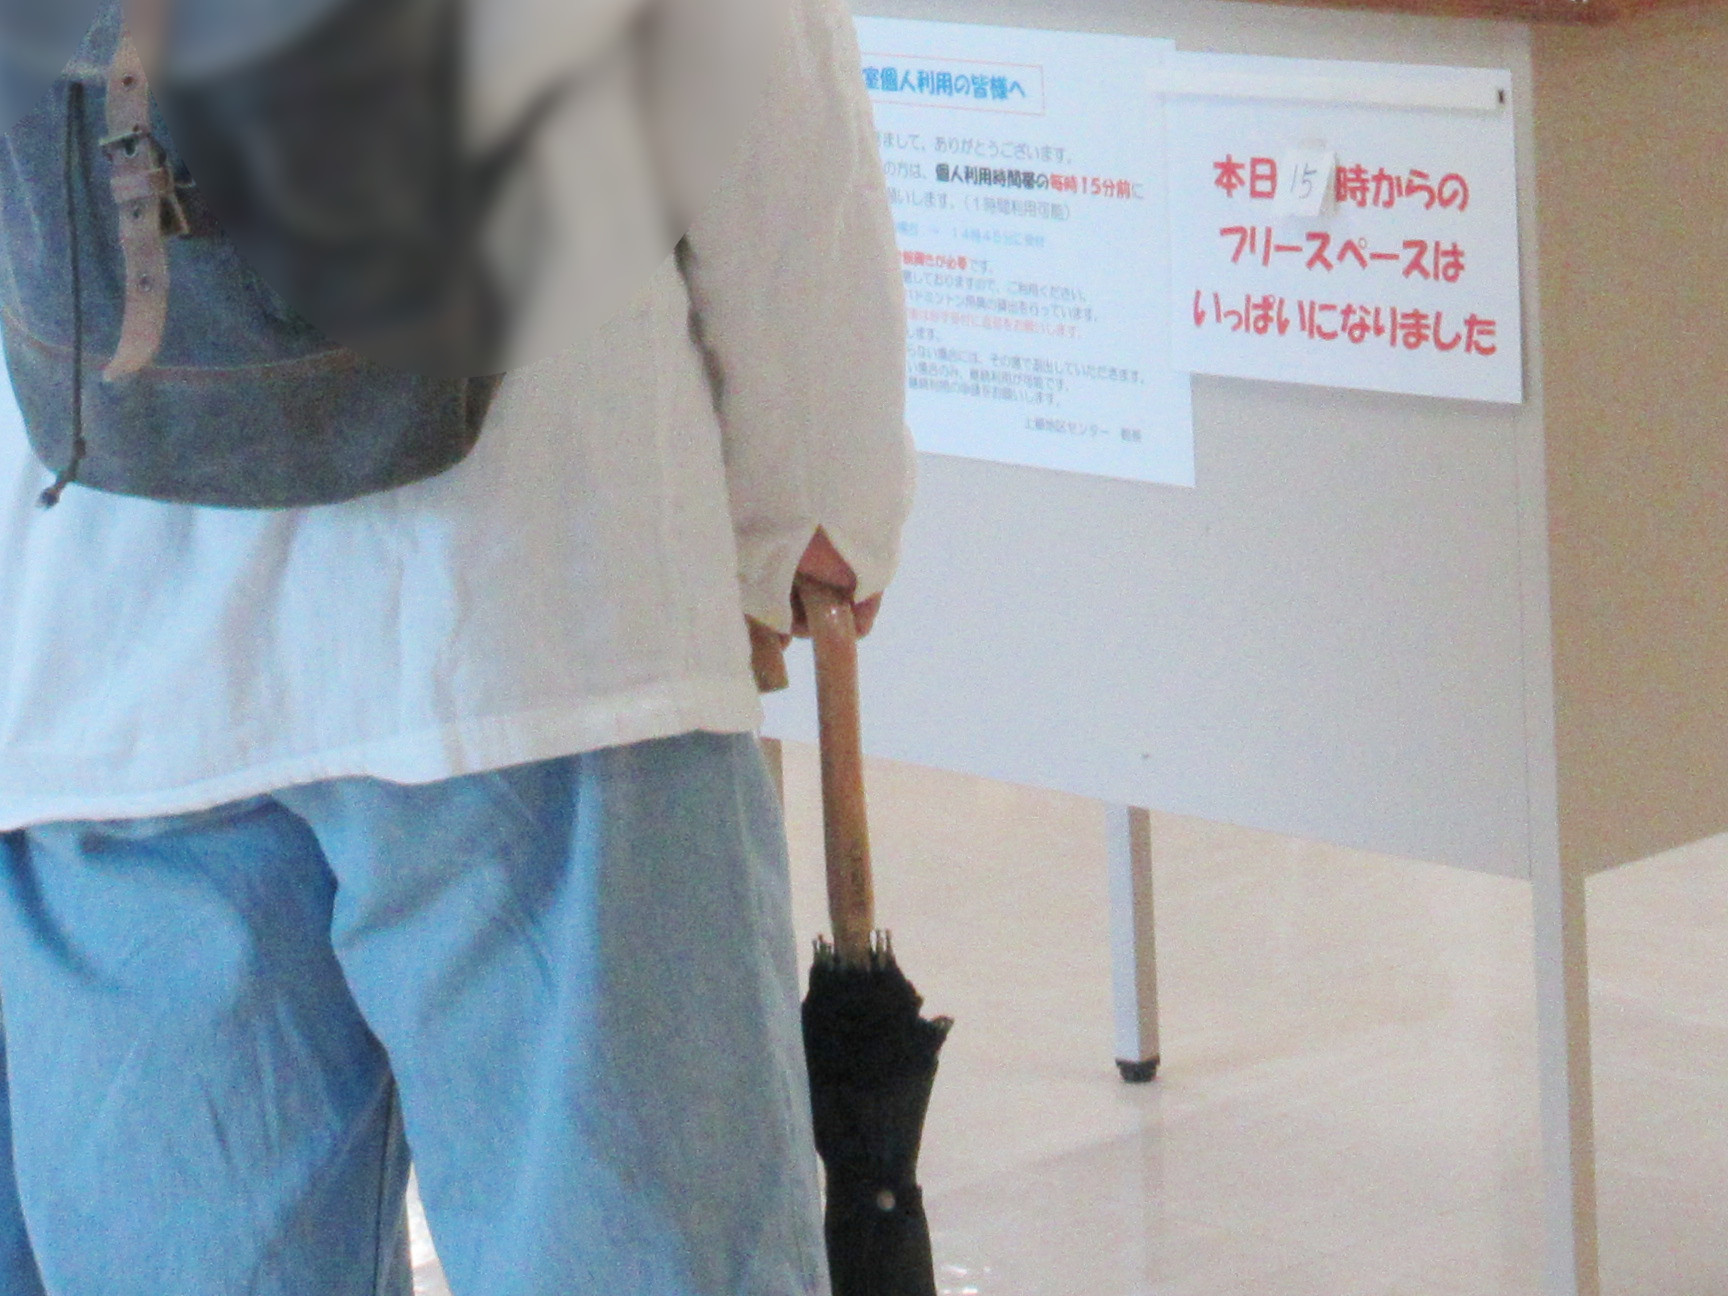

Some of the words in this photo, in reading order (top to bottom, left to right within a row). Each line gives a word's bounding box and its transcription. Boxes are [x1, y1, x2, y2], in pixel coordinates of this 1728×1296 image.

[1220, 226, 1466, 283] フリースペースは
[1193, 289, 1497, 356] いっぱいになりました
